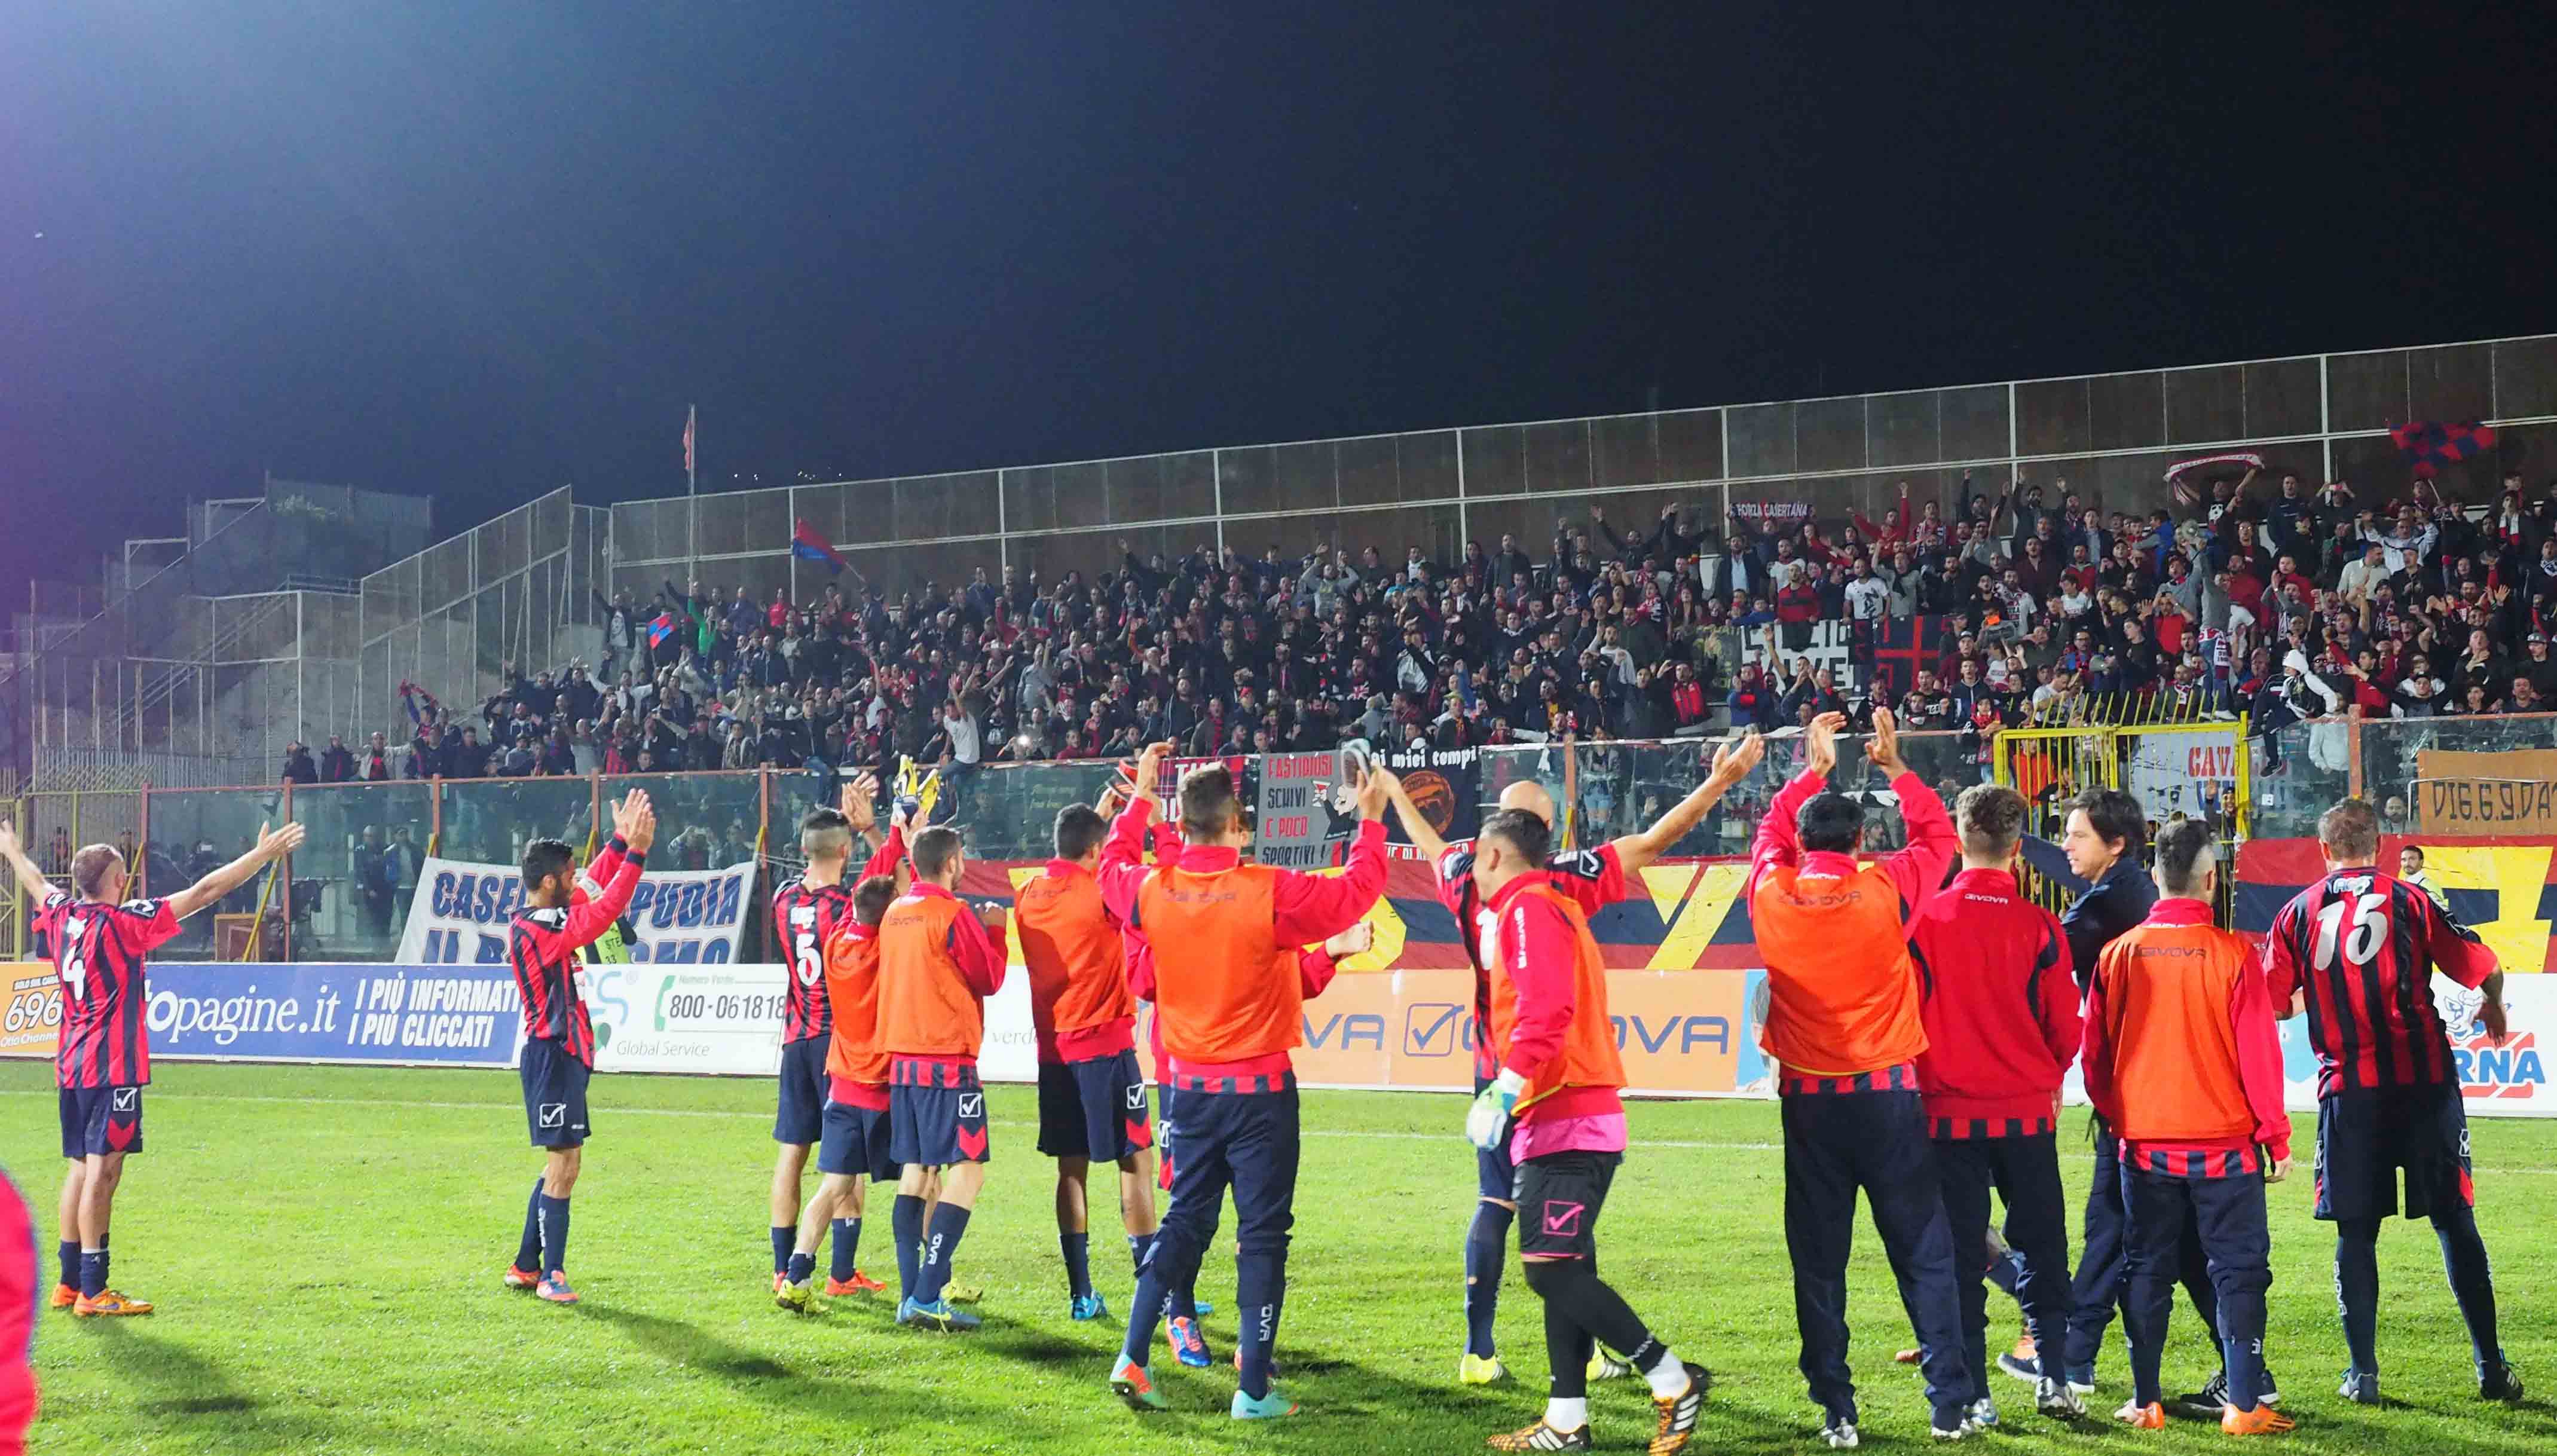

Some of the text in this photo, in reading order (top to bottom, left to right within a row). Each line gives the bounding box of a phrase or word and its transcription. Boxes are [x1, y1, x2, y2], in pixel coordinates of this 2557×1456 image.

[1267, 755, 1332, 778] FASTIDIOSI
[1267, 787, 1306, 809] SCHIVI
[1278, 816, 1308, 837] POCO
[355, 978, 366, 1010] I
[368, 971, 406, 1011] PIÙ
[4, 989, 63, 1033] 696
[347, 1013, 359, 1045] I
[401, 1014, 495, 1048] CLICCATI
[992, 1027, 1038, 1045] verd
[616, 1040, 710, 1057] Global Service
